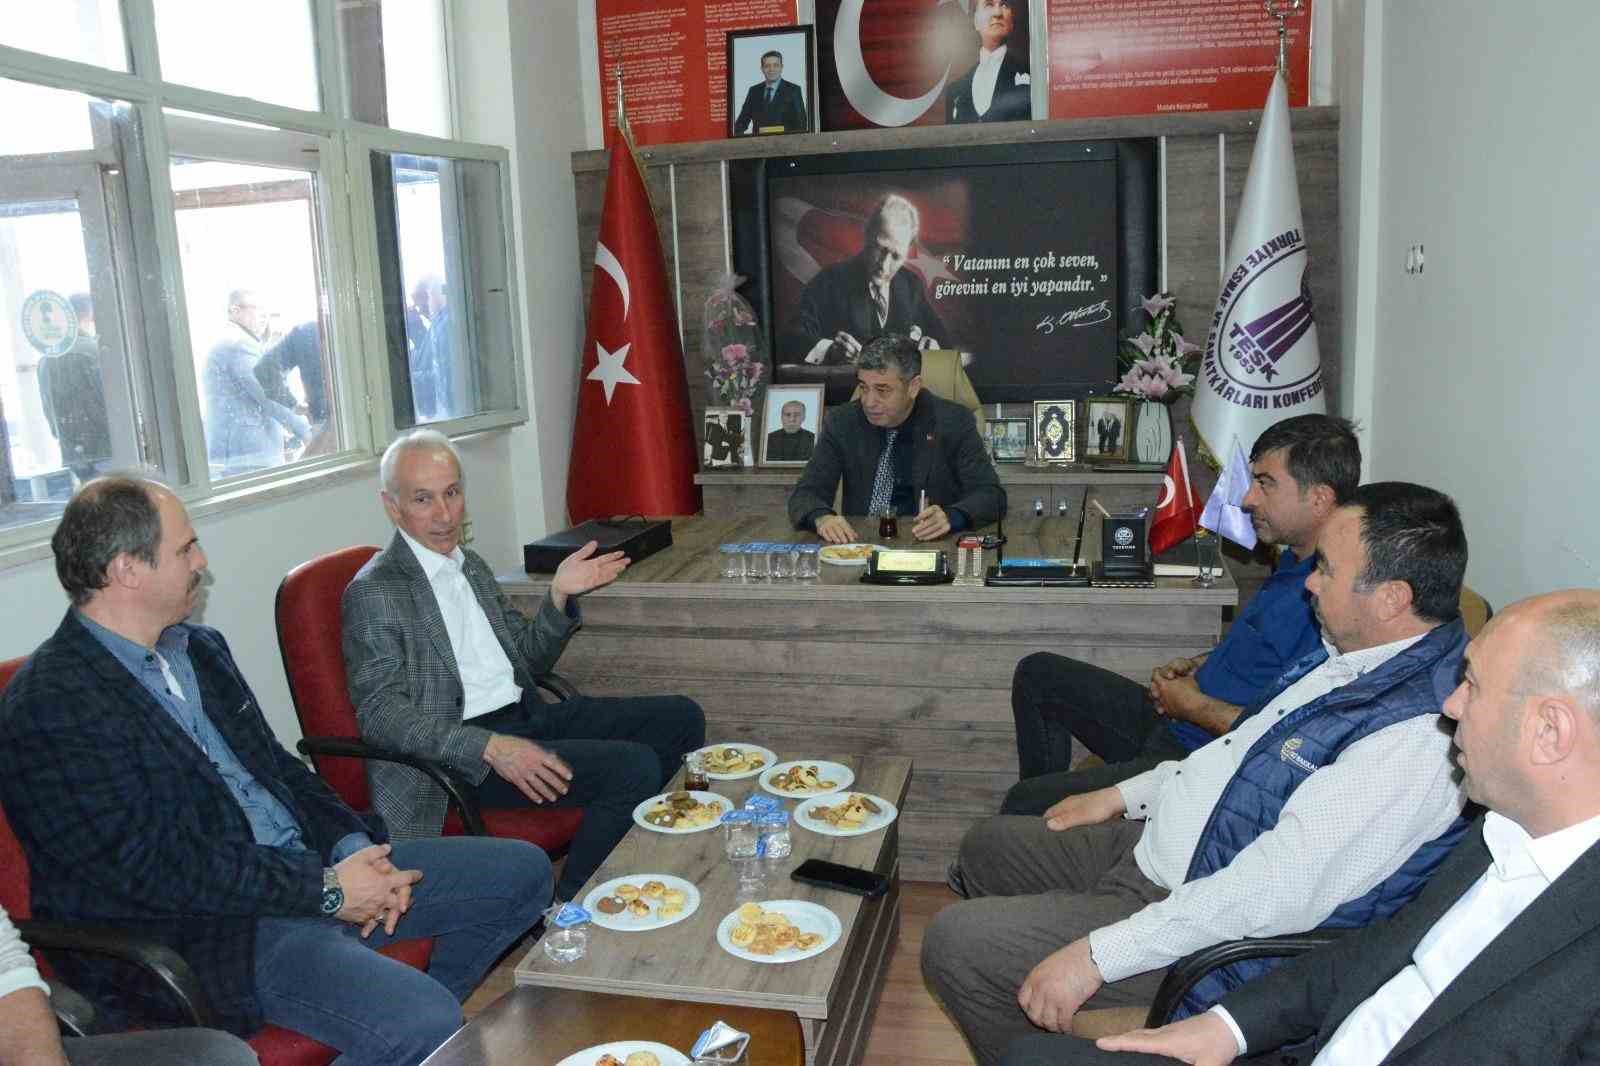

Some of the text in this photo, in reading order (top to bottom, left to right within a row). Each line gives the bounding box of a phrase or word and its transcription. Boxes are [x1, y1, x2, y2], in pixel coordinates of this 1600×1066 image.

[1014, 256, 1029, 269] en
[1033, 252, 1056, 272] çok
[1059, 254, 1099, 270] seven,
[1246, 229, 1302, 268] TÜRKİYE
[935, 278, 988, 299] görevini
[991, 281, 1007, 294] en
[1010, 276, 1028, 296] iyi
[1220, 264, 1249, 307] ESNAF
[1228, 344, 1255, 374] 1953
[1229, 322, 1280, 383] TESK
